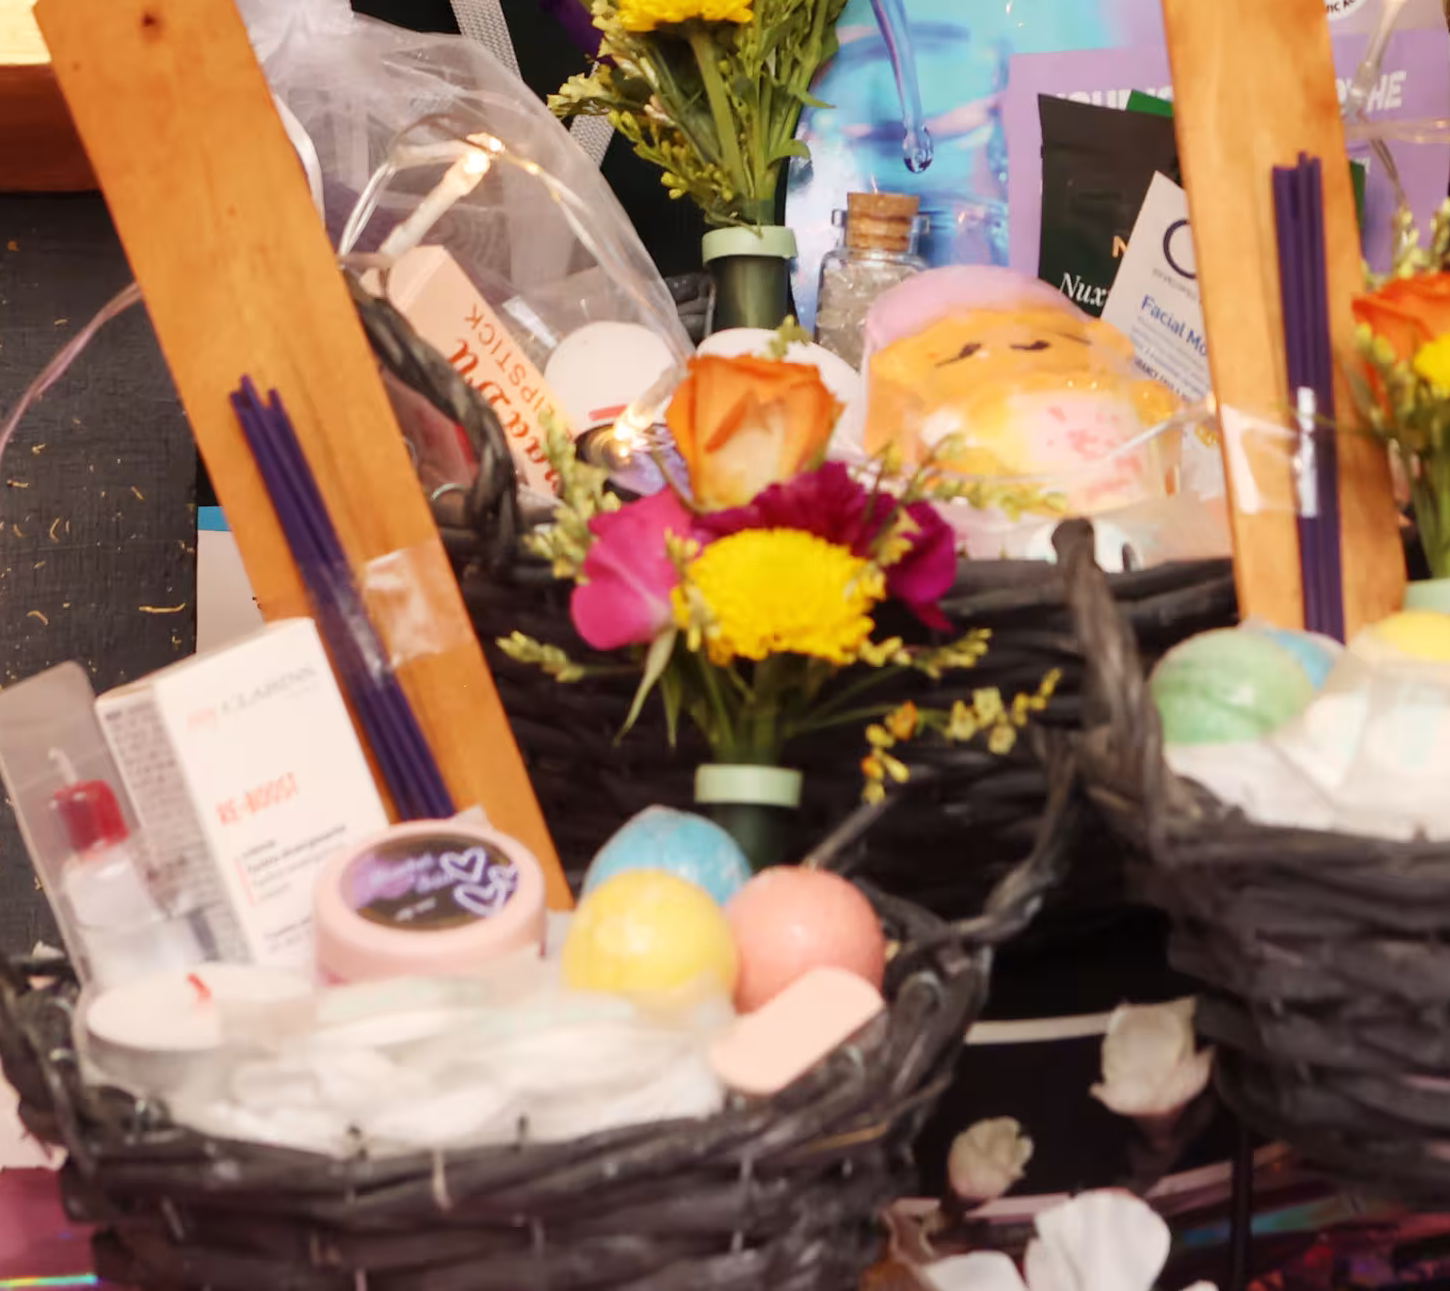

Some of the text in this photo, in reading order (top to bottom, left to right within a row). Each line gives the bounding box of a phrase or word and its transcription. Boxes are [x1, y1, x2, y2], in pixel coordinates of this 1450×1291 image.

[1060, 272, 1107, 308] Nux
[1142, 294, 1186, 339] Facial
[1186, 328, 1208, 357] Mo
[464, 303, 555, 419] LIPSTICK
